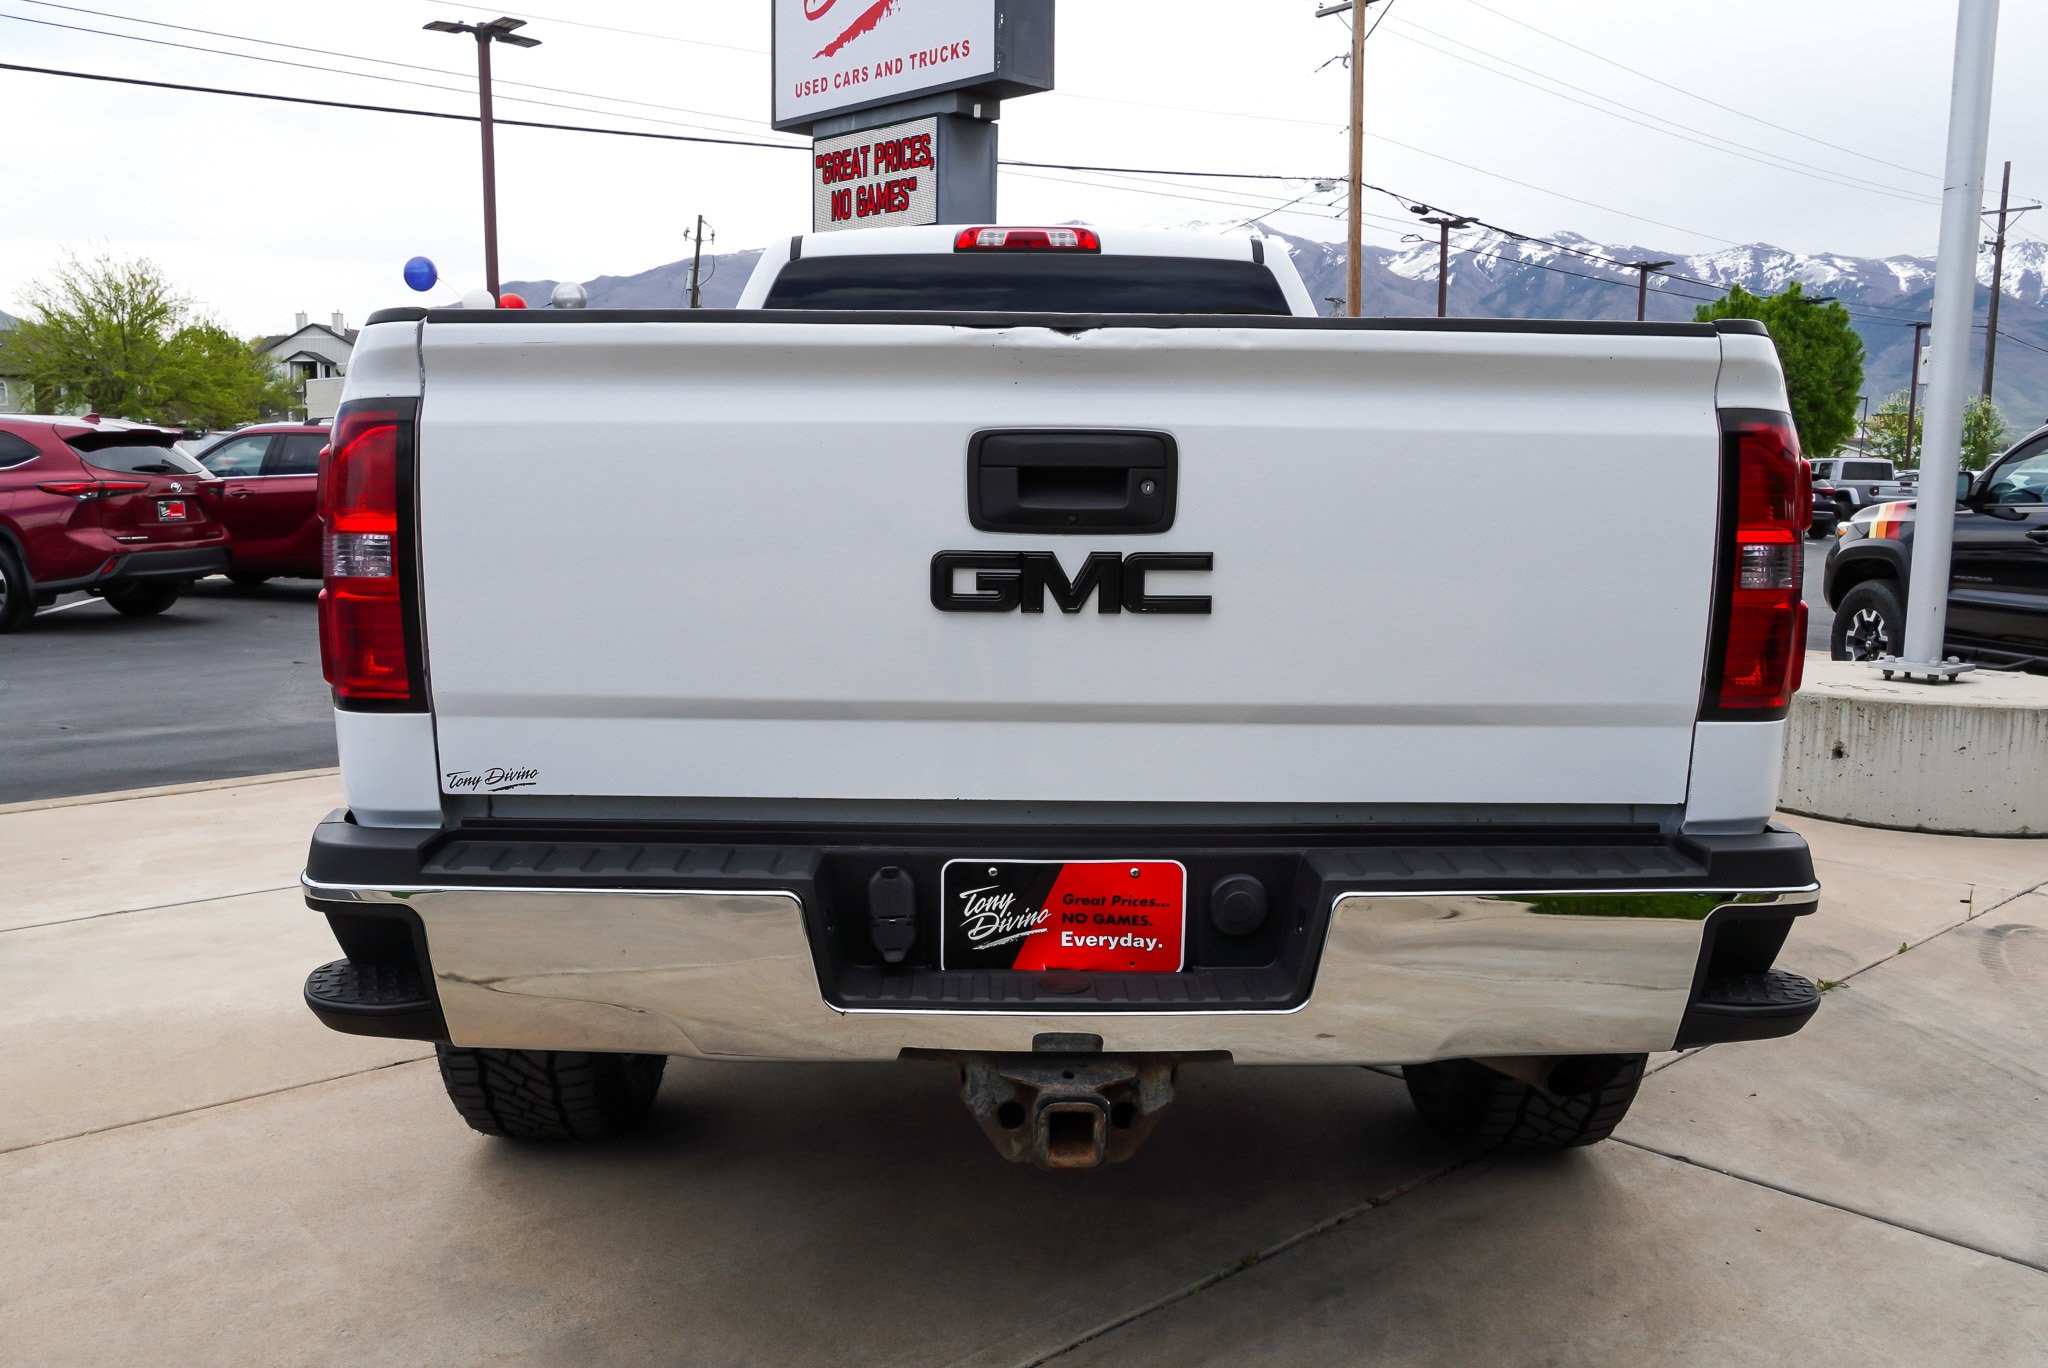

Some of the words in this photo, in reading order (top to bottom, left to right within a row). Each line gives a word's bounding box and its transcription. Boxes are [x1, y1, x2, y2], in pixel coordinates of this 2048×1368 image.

[795, 77, 828, 98] USED
[834, 66, 869, 89] CARS
[874, 57, 903, 80] AND
[909, 39, 971, 70] TRUCKS
[874, 133, 935, 175] PRICES,
[831, 188, 852, 222] NO
[930, 550, 1213, 614] GMC
[446, 770, 483, 791] Tony
[484, 766, 540, 785] Divino
[959, 885, 1016, 917] Tony
[1062, 893, 1107, 907] Great
[1110, 895, 1171, 908] Prices...
[959, 909, 1052, 941] Divino
[1061, 913, 1088, 925] NO
[1092, 913, 1153, 927] GAMES.
[1060, 931, 1163, 951] Everyday.
